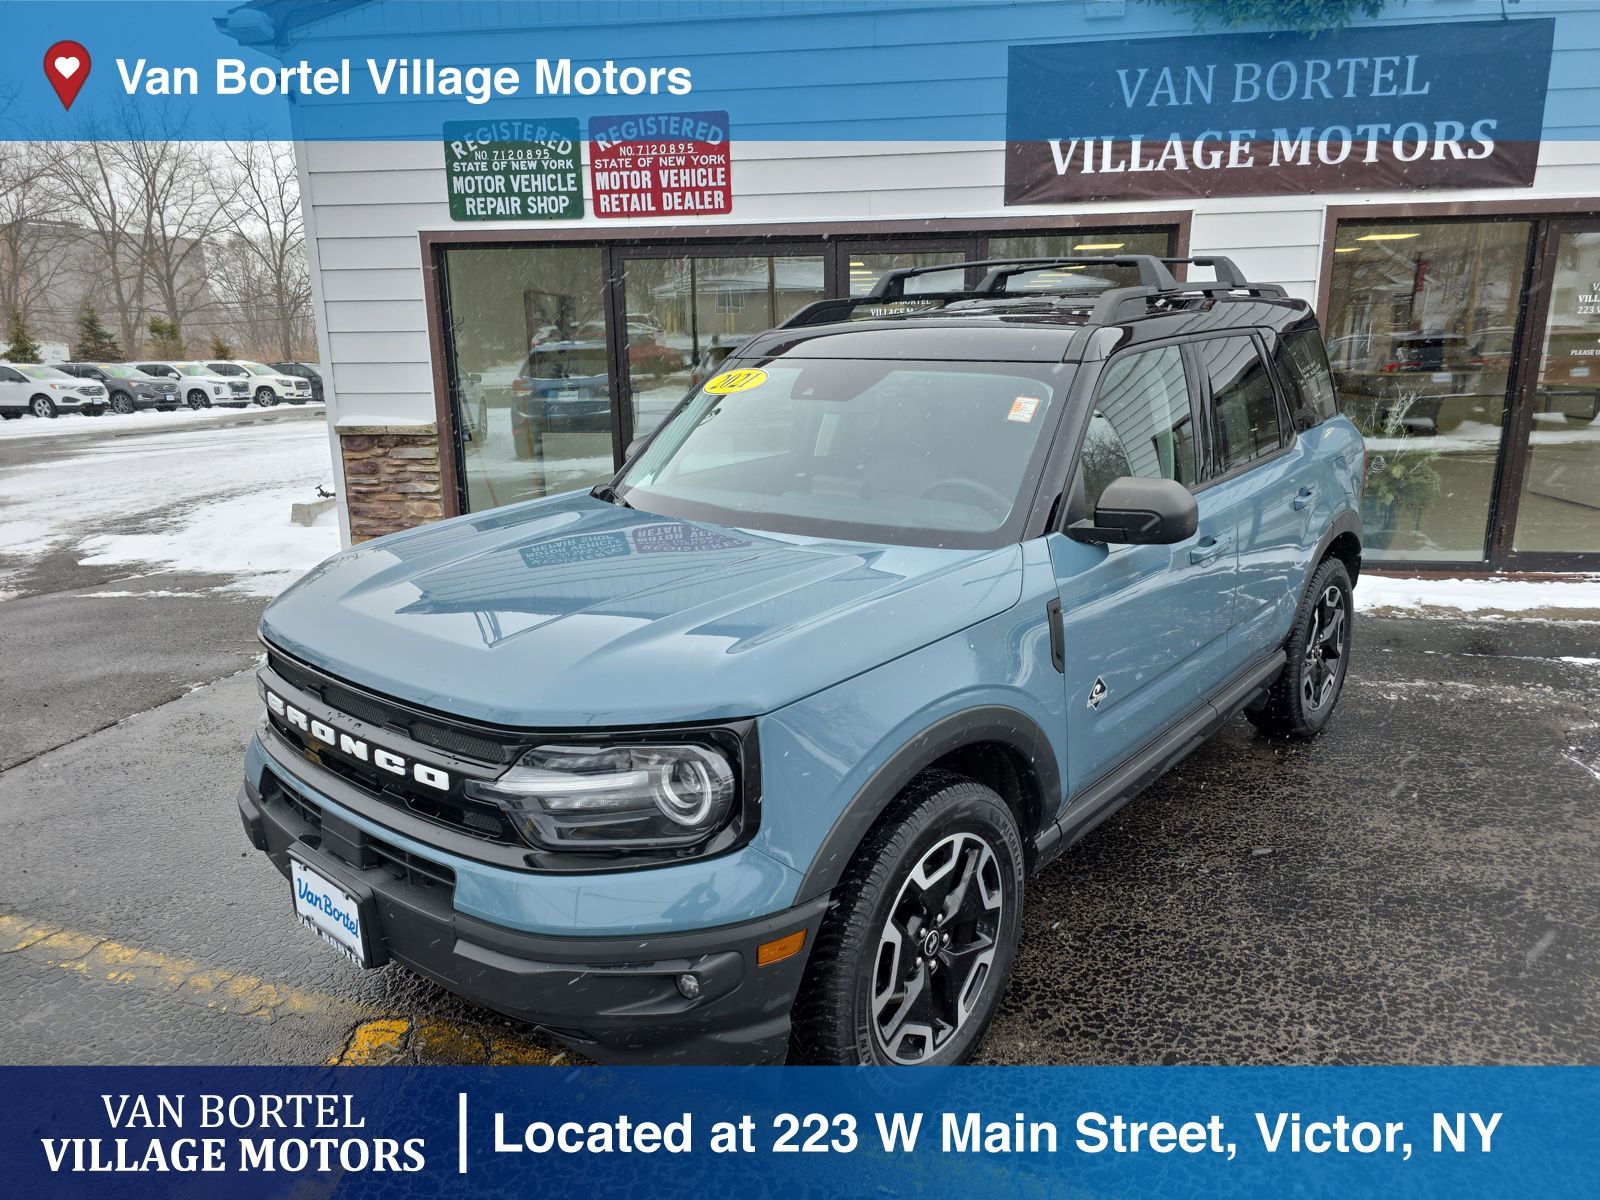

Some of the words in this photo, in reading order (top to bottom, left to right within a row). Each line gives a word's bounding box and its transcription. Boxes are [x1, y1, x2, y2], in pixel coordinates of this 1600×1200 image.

[1116, 64, 1216, 108] VAN
[1231, 54, 1430, 103] BORTEL
[450, 121, 573, 159] REGISTERED
[594, 115, 724, 152] REGISTERED
[492, 148, 550, 160] 7120895
[620, 145, 635, 157] NO.
[638, 143, 695, 155] 7120895
[1047, 127, 1256, 176] VILLAGE
[1268, 118, 1497, 167] MOTORS
[453, 161, 489, 172] STATE
[492, 160, 508, 171] OF
[511, 160, 538, 171] NEW
[541, 159, 574, 170] YORK
[594, 158, 633, 169] STATE
[637, 157, 654, 168] OF
[659, 156, 686, 167] NEW
[691, 154, 726, 165] YORK
[452, 175, 506, 194] MOTOR
[510, 172, 577, 193] VEHICLE
[595, 170, 652, 190] MOTOR
[659, 167, 727, 189] VEHICLE
[465, 196, 521, 215] REPAIR
[527, 195, 570, 214] SHOP
[600, 192, 656, 213] RETAIL
[662, 190, 725, 211] DEALER
[1577, 306, 1594, 314] 223
[709, 372, 762, 389] 2021
[267, 691, 450, 791] BRONCO
